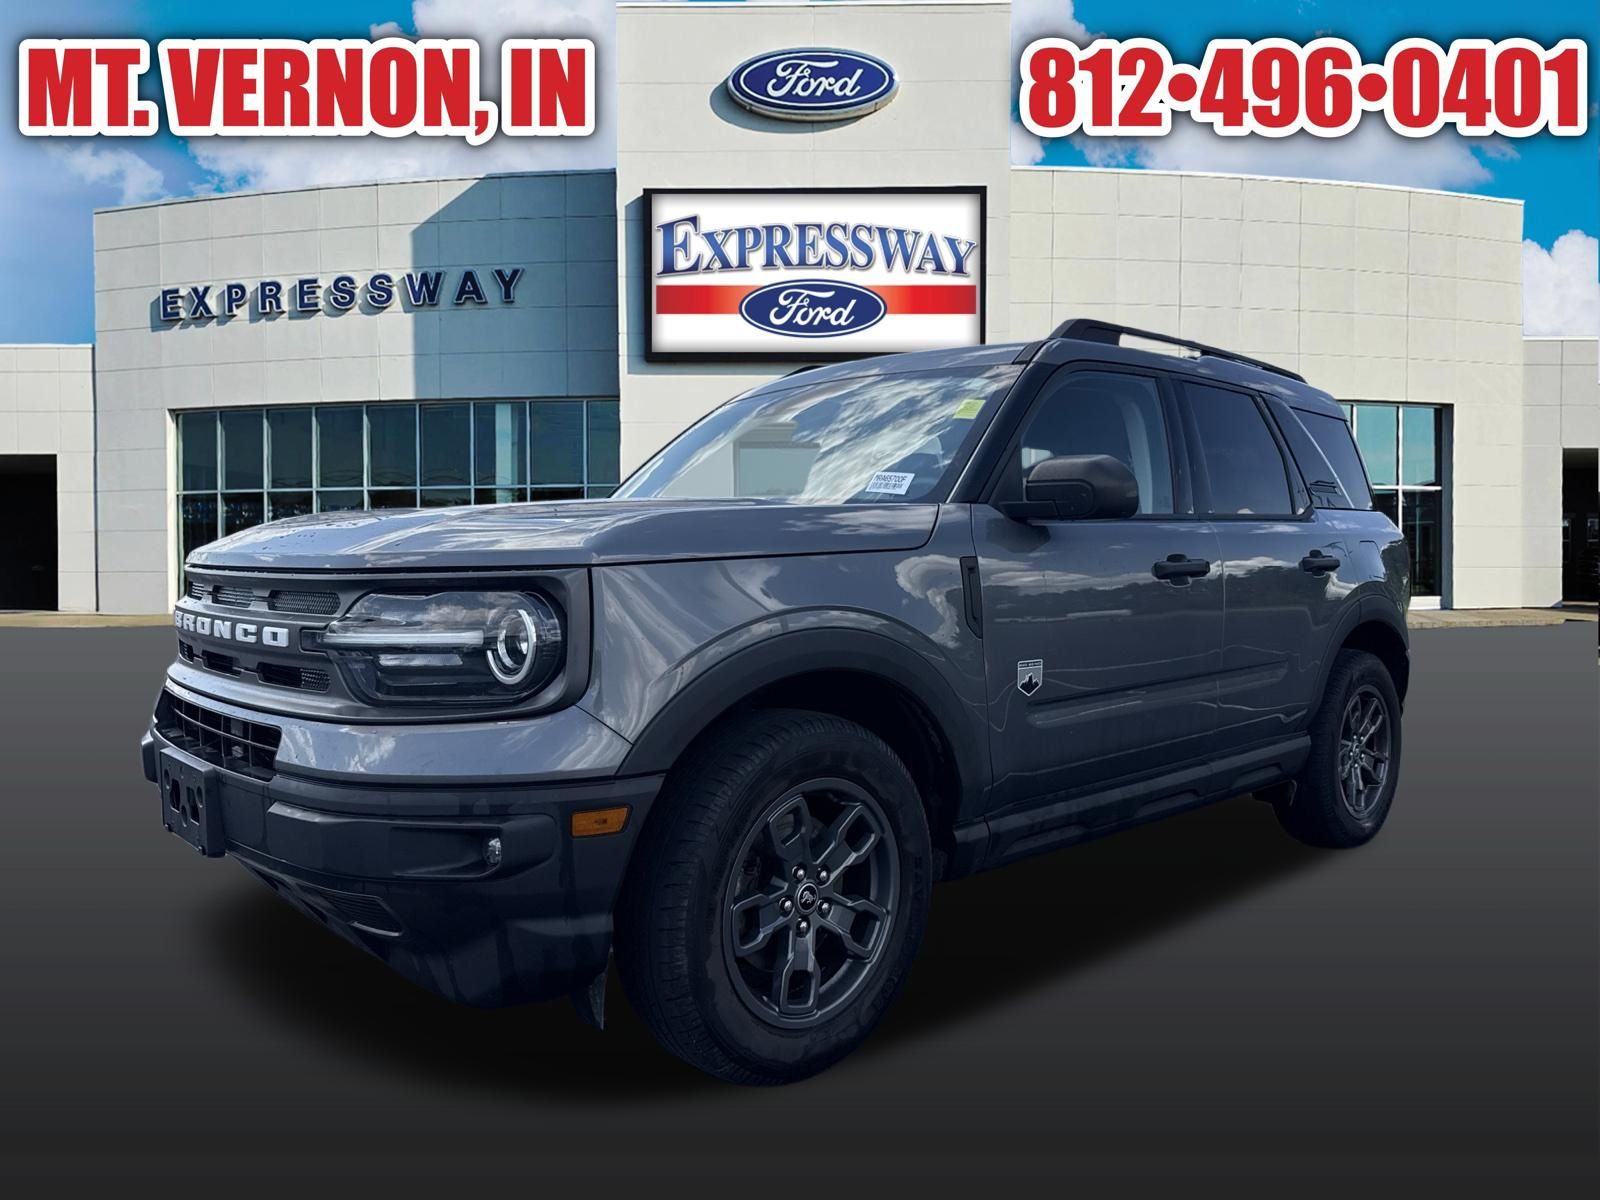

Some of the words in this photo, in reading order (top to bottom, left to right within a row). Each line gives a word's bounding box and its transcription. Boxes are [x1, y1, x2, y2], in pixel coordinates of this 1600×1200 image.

[766, 58, 864, 97] Ford
[159, 267, 524, 321] EXPRESSWAY
[769, 288, 857, 326] Ford
[175, 610, 289, 648] BRONCO
